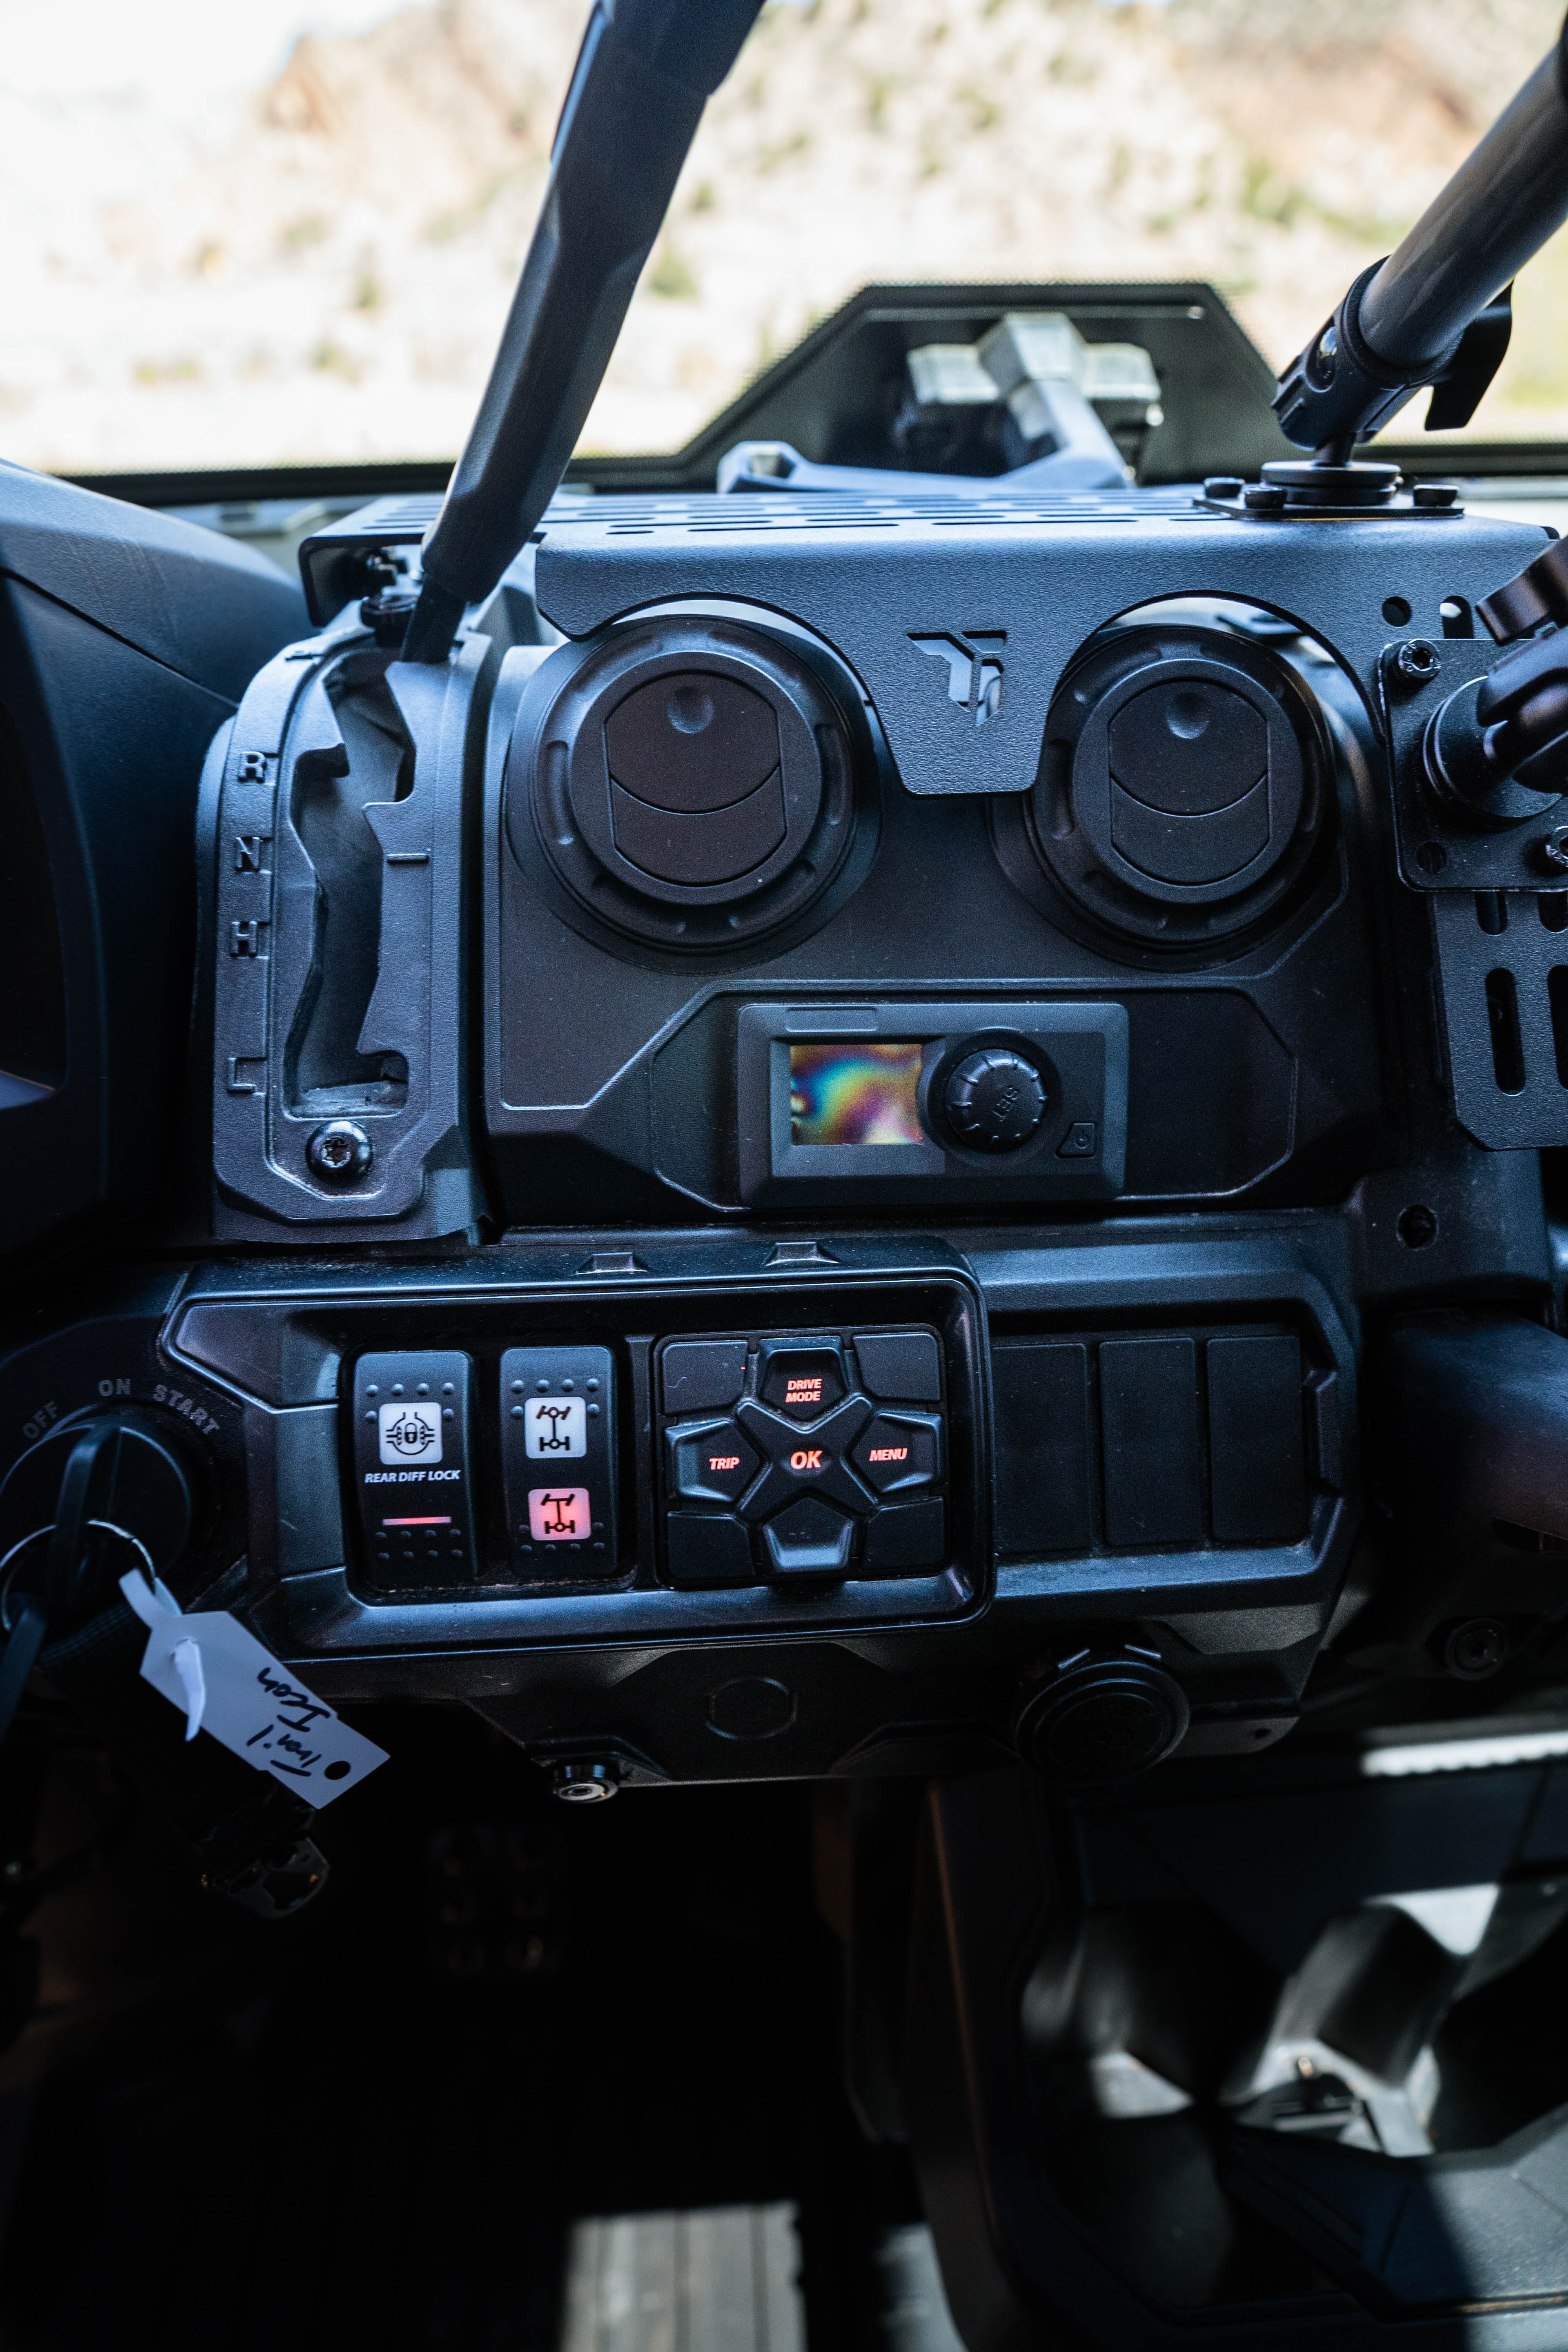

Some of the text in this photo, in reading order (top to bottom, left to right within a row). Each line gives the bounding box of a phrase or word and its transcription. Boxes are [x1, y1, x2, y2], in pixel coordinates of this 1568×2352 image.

[240, 751, 267, 783] R
[235, 837, 261, 873] N
[230, 920, 258, 958] H
[228, 1057, 256, 1093] L
[991, 1084, 1020, 1122] SET
[98, 1378, 131, 1397] ON
[785, 1390, 821, 1403] MODE
[787, 1378, 822, 1390] DRIVE
[22, 1401, 58, 1439] OFF
[152, 1384, 220, 1435] START
[709, 1457, 740, 1470] TRIP
[790, 1450, 823, 1470] OK
[869, 1448, 908, 1462] MENU
[364, 1470, 461, 1483] REAR DIFF LOCK
[257, 1667, 331, 1732] Icon
[246, 1724, 322, 1777] Trail
